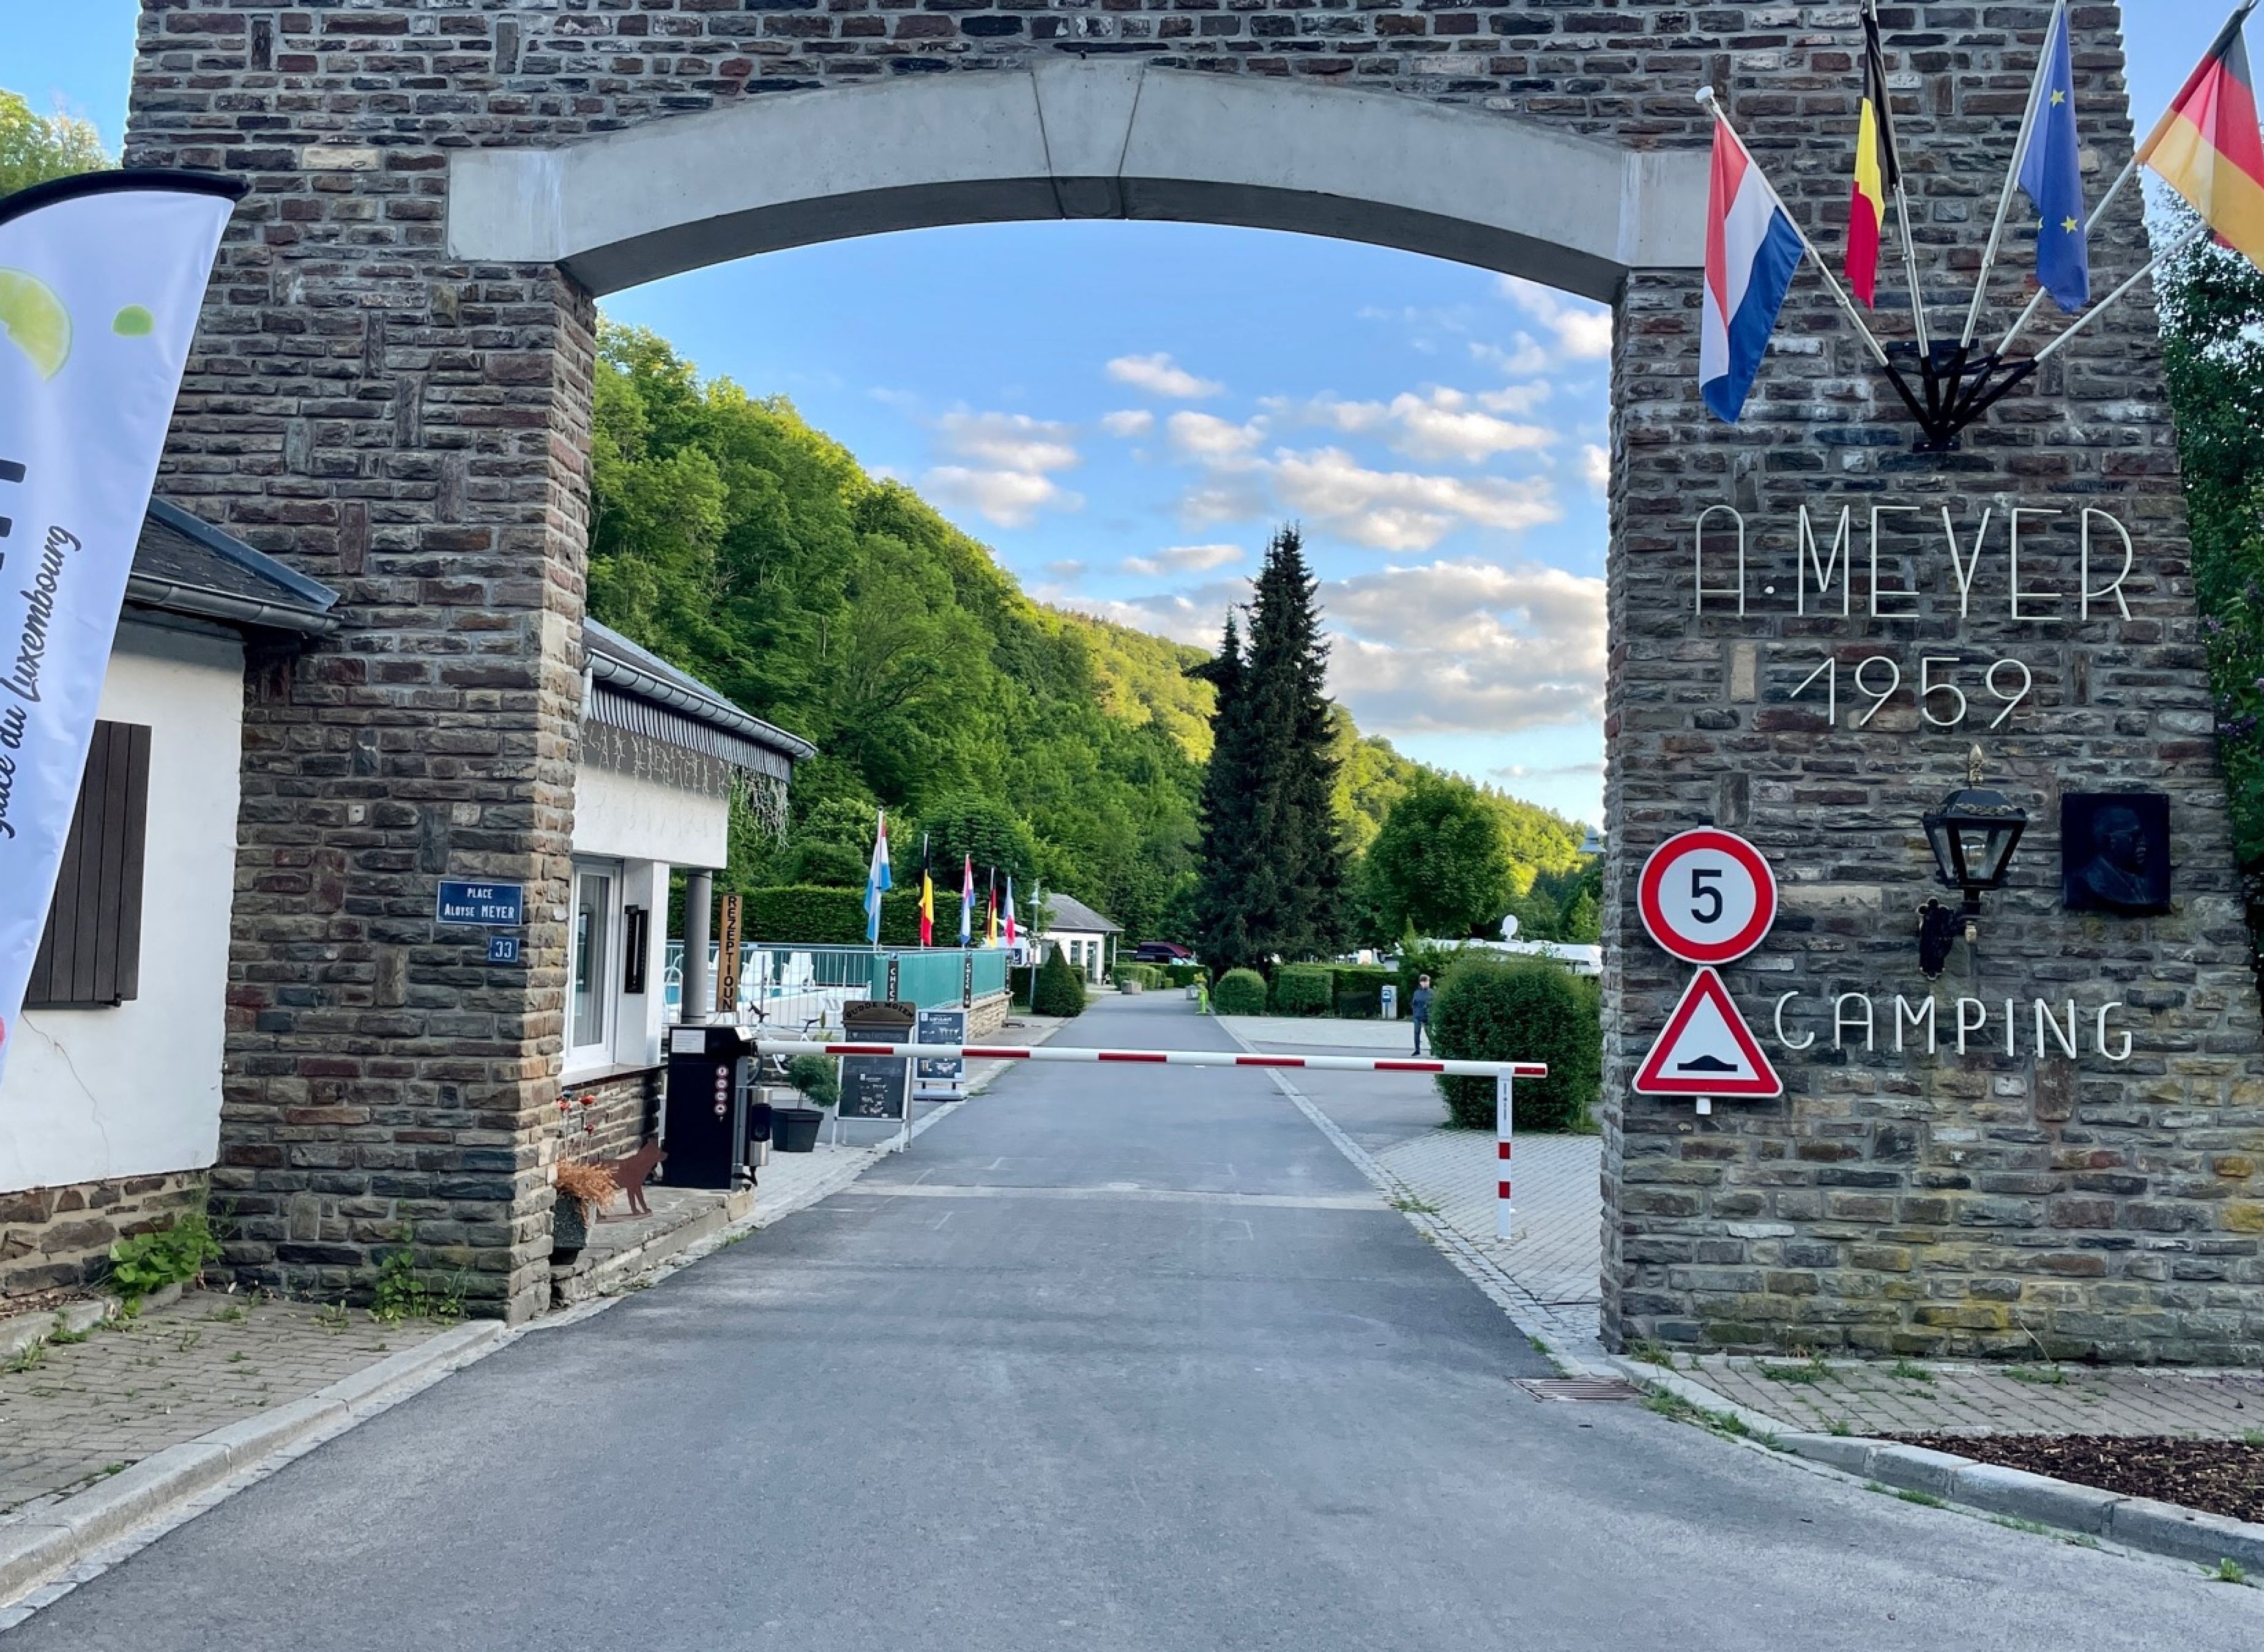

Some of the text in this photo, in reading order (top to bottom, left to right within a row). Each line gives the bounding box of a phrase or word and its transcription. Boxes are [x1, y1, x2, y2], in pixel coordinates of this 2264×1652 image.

[0, 524, 82, 702] Luxembourg
[1790, 656, 2031, 729] 1959
[0, 704, 27, 749] du
[467, 887, 493, 899] PLACE
[482, 905, 515, 918] MEYER
[1691, 869, 1722, 924] 5
[496, 941, 512, 958] 33
[723, 896, 737, 1010] REZEPTIOUN
[1775, 991, 2132, 1060] CAMPING
